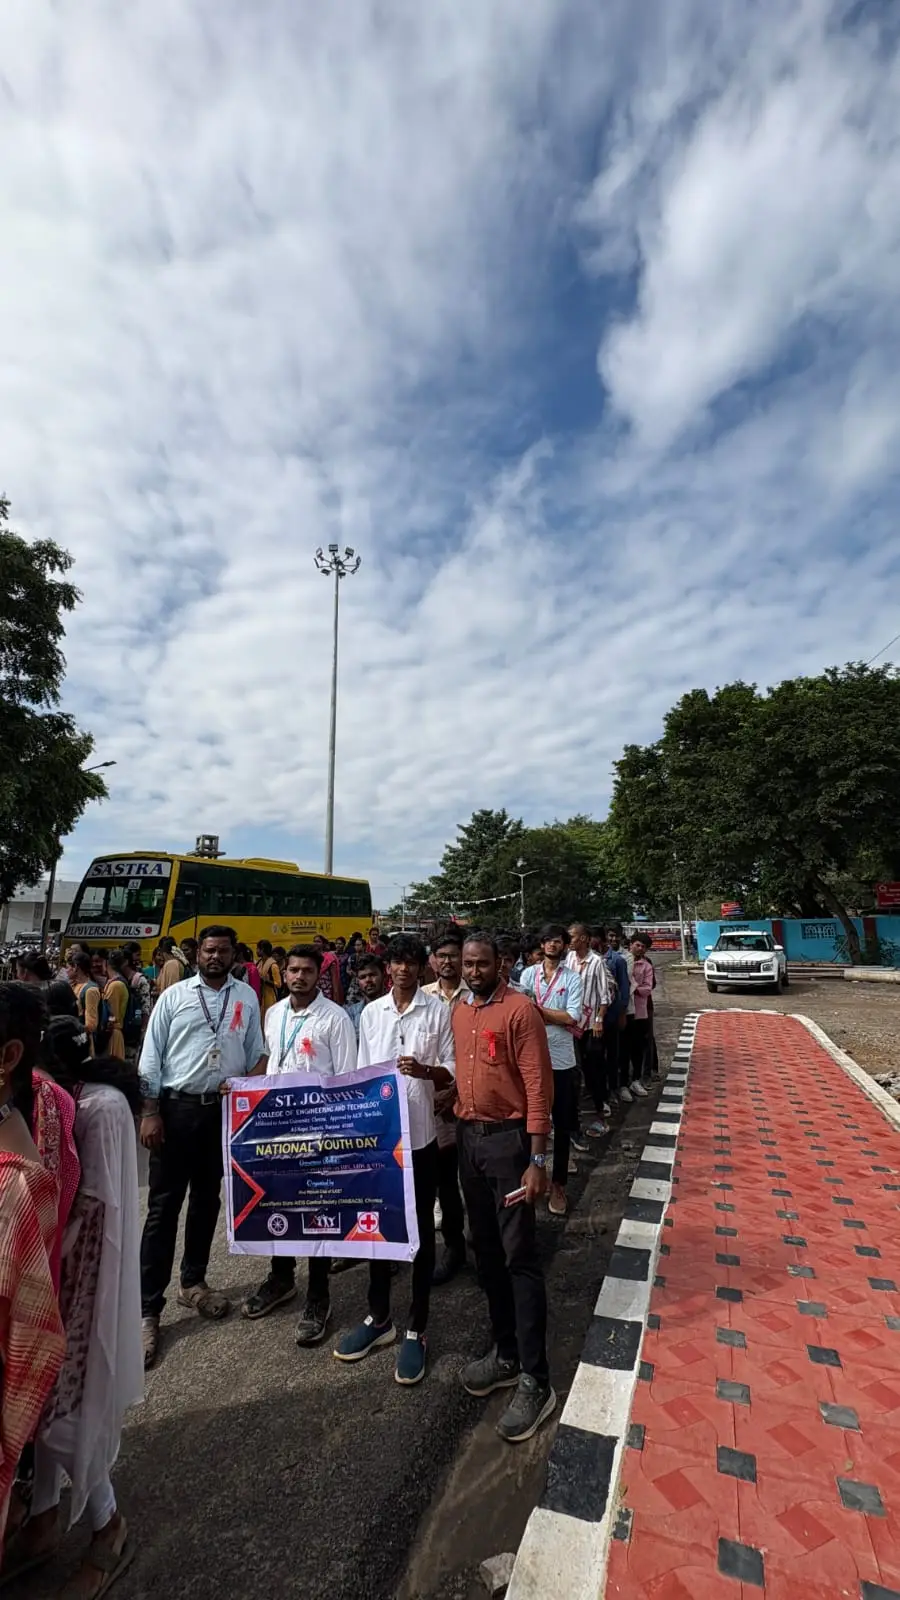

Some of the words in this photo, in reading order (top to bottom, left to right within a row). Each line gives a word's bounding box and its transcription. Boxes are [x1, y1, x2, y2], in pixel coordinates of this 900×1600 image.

[92, 863, 163, 876] SASTRA
[68, 926, 120, 936] UNIVERSITY
[121, 926, 142, 936] BUS
[275, 1094, 297, 1108] ST.
[257, 1110, 284, 1119] COLLEGE
[296, 1106, 334, 1116] ENGINEERING
[347, 1101, 380, 1111] TECHNOLOGY
[256, 1141, 315, 1156] NATIONAL
[317, 1138, 353, 1152] YOUTH
[356, 1136, 378, 1149] DAY
